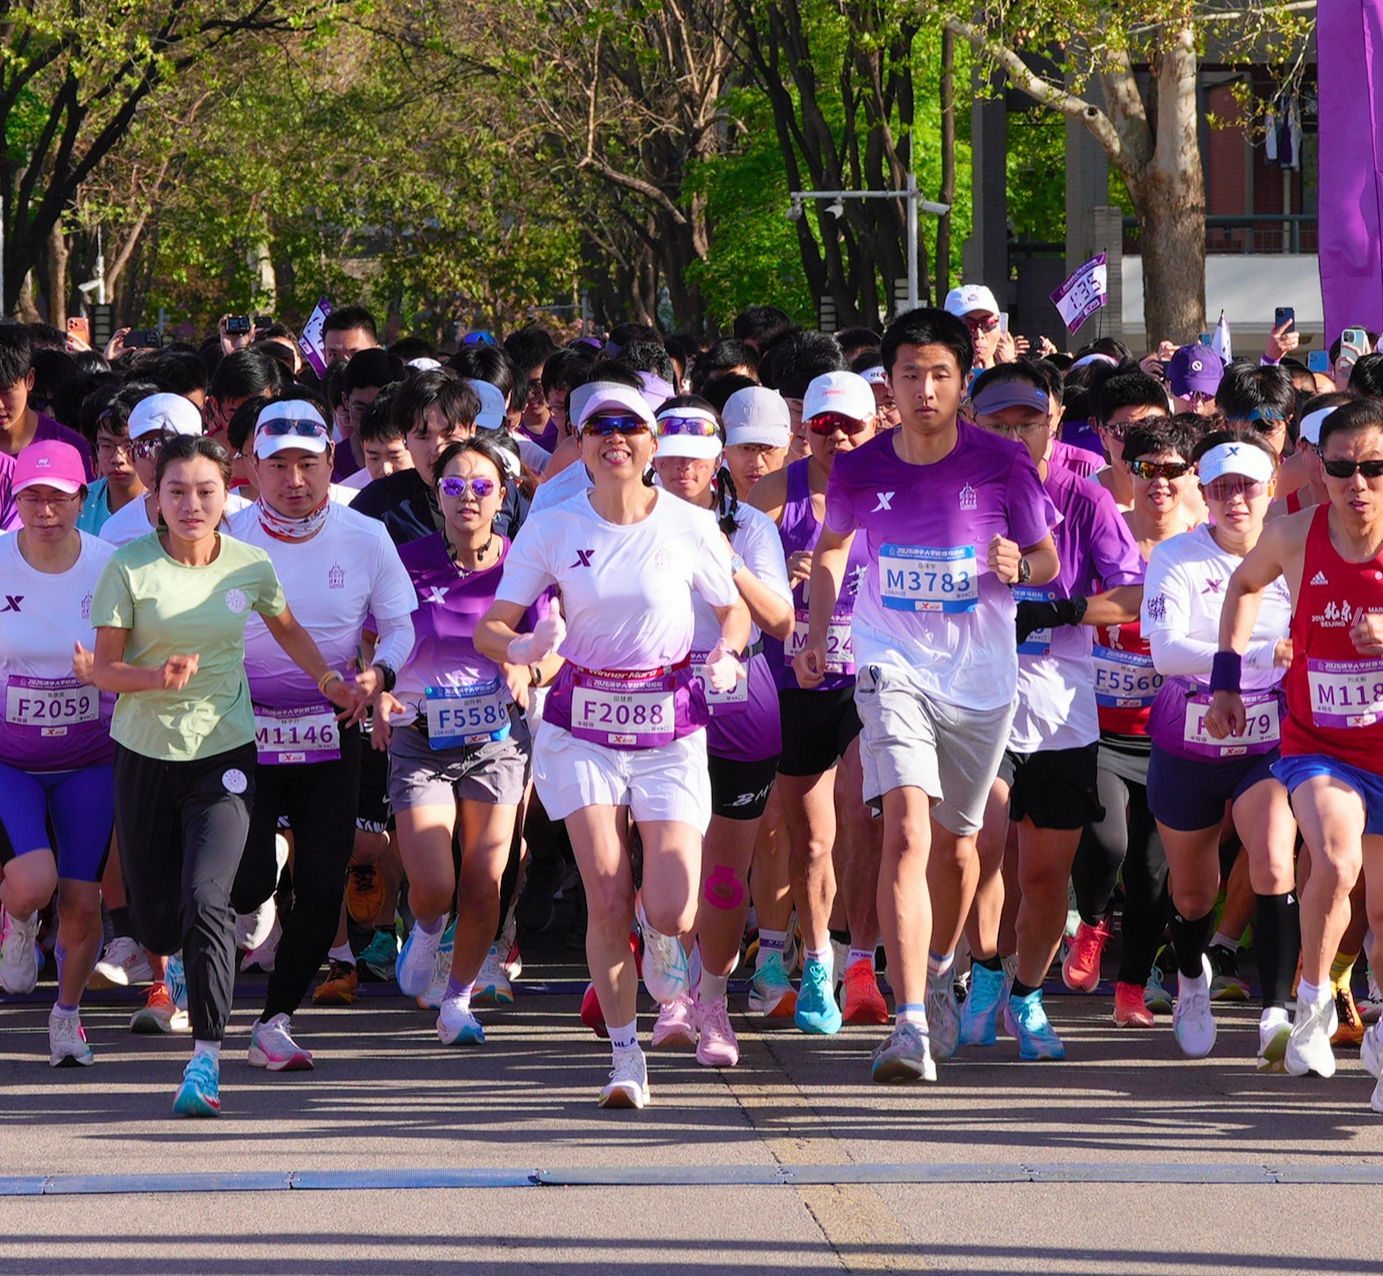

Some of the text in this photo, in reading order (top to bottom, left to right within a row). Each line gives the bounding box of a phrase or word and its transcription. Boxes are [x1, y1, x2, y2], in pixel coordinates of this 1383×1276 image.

[886, 569, 971, 593] M3783
[1095, 668, 1165, 692] F5560
[18, 694, 91, 719] F2059
[438, 701, 507, 730] F5586
[583, 700, 664, 725] F2088
[255, 724, 334, 747] M1146
